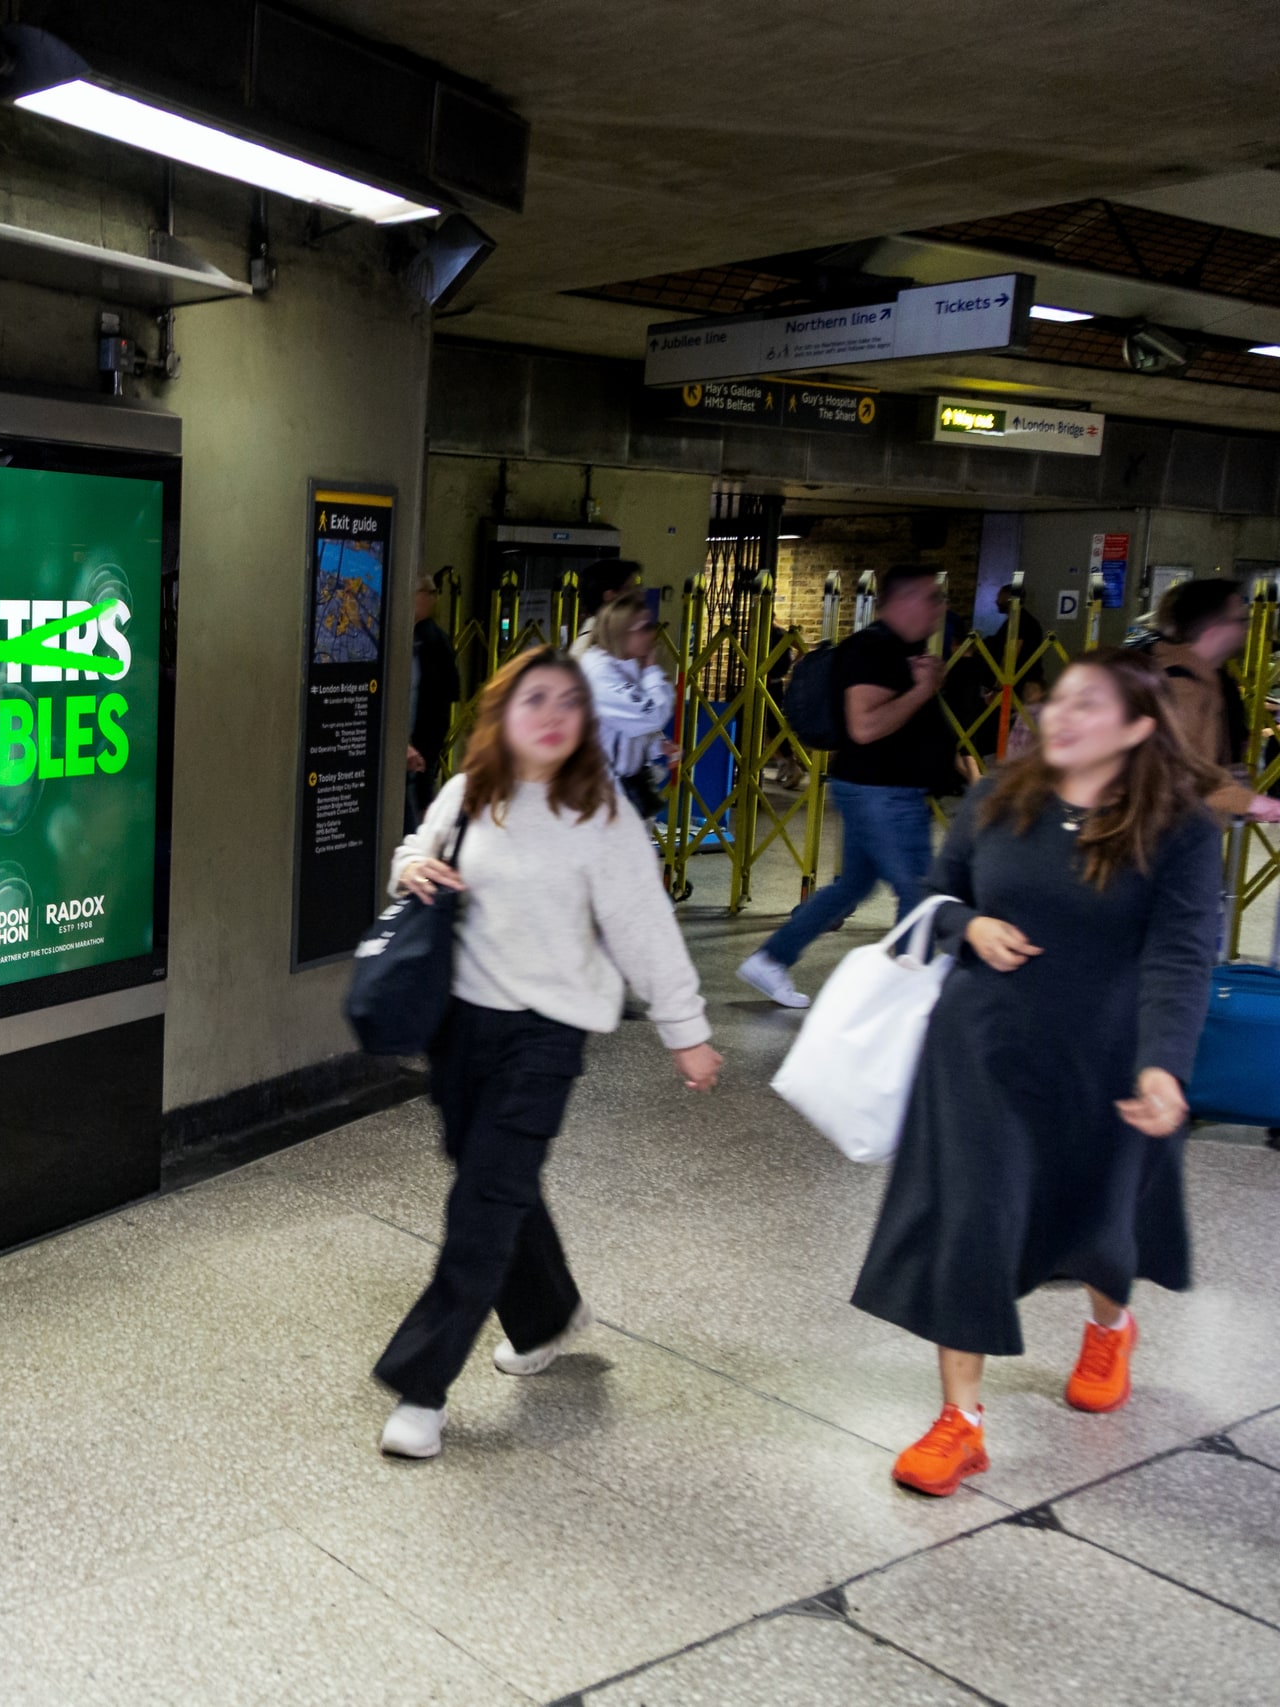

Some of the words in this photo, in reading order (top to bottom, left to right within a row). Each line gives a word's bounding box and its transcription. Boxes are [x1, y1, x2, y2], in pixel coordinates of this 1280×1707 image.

[935, 297, 991, 314] Tickets
[785, 316, 847, 334] Northern
[851, 312, 877, 326] line
[661, 335, 702, 351] Jubilee
[705, 331, 727, 345] line
[705, 384, 728, 396] Hay's
[730, 385, 762, 399] Galleria
[704, 397, 725, 408] HMS
[727, 399, 756, 412] Belfast
[801, 392, 824, 406] Guy's
[825, 395, 857, 409] Hospital
[819, 408, 834, 420] The
[835, 410, 856, 422] Shard
[1022, 418, 1056, 433] London
[1057, 421, 1085, 439] Bridge
[330, 514, 350, 530] Exit
[352, 516, 378, 534] guide
[1060, 595, 1077, 615] D
[319, 684, 340, 694] London
[340, 683, 358, 694] Bridge
[358, 682, 369, 692] exit
[318, 774, 337, 783] Tooley
[337, 771, 354, 780] Street
[354, 769, 365, 778] exit
[46, 895, 105, 925] RADOX
[77, 920, 93, 931] 1908
[22, 951, 29, 959] OF
[30, 949, 40, 957] THE
[41, 946, 52, 955] TCS
[52, 942, 74, 954] LONDON
[74, 937, 105, 949] MARATHON
